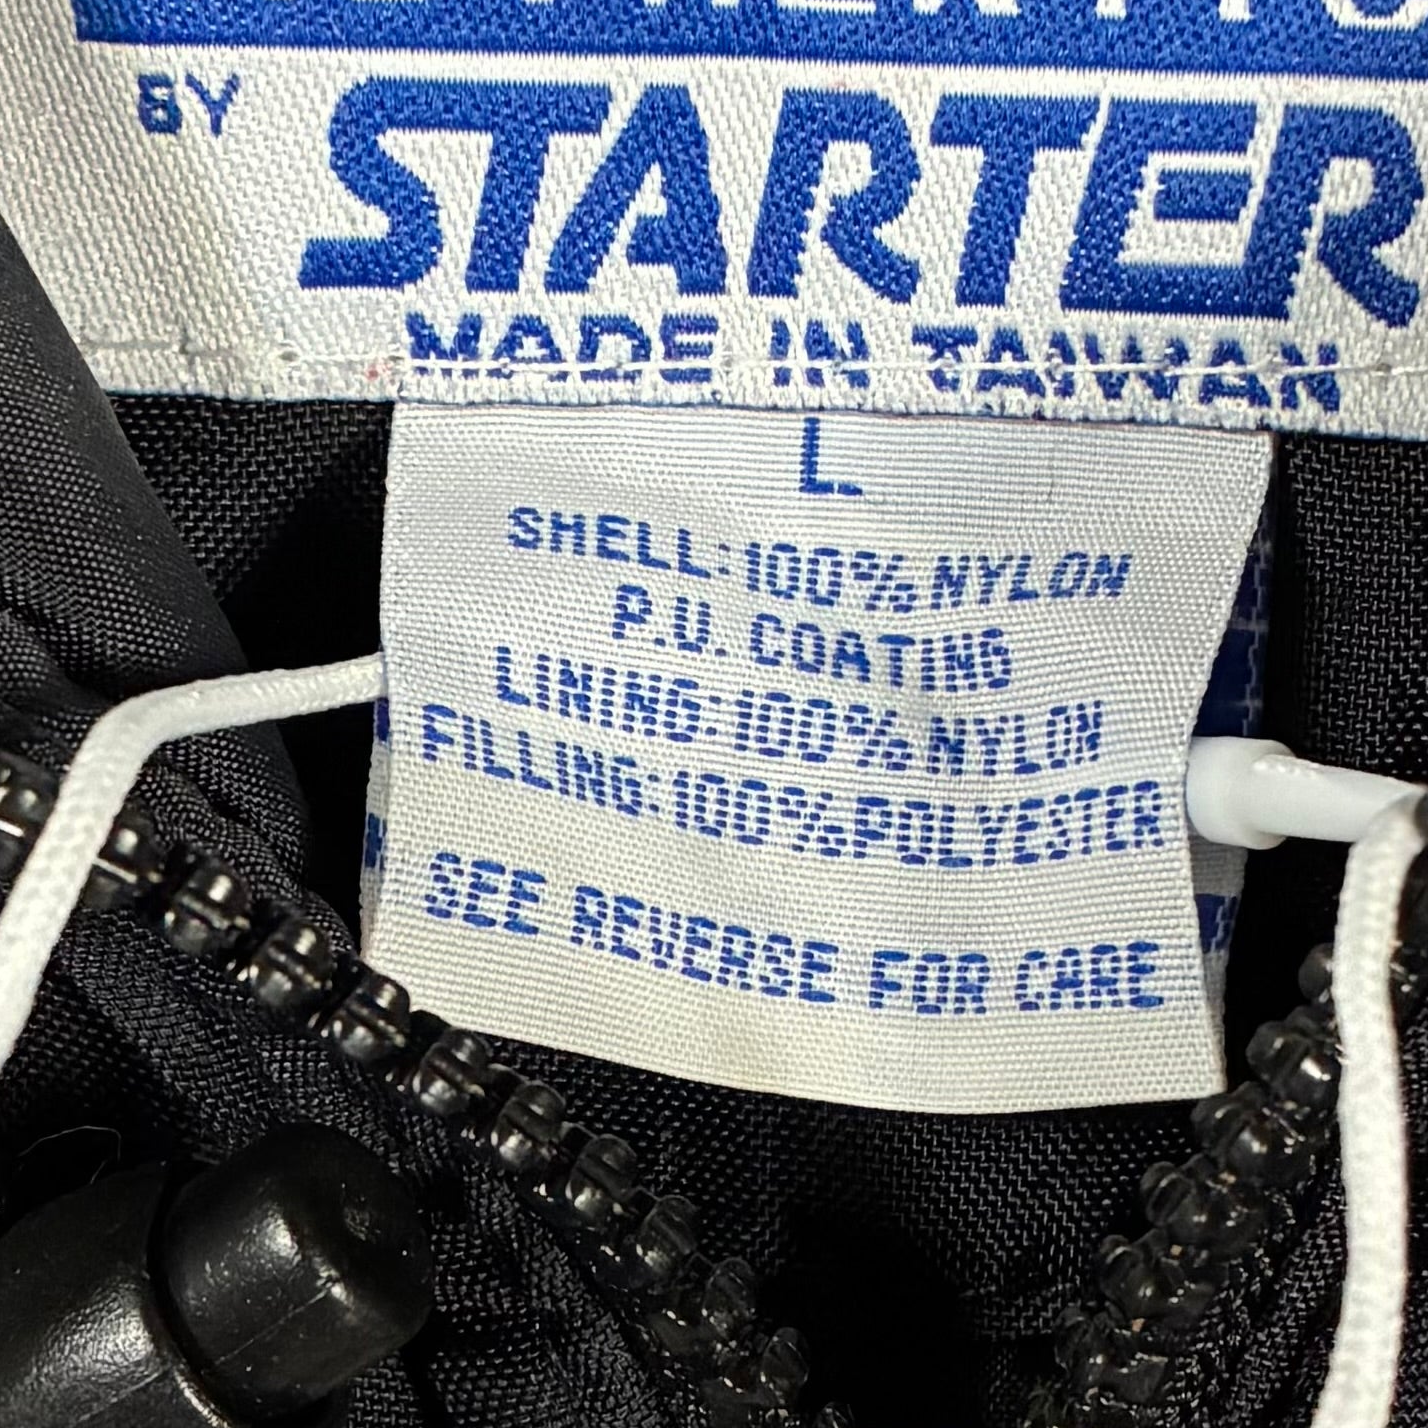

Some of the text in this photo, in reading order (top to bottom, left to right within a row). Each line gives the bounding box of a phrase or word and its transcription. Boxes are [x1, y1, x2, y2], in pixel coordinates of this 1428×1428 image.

[298, 75, 1426, 330] STARTER
[405, 312, 1342, 414] MADE IN TAIWAN
[797, 416, 863, 495] L
[611, 584, 1013, 694] P.U. COATING
[423, 851, 1165, 1015] SEE REVERSE FOR CARE
